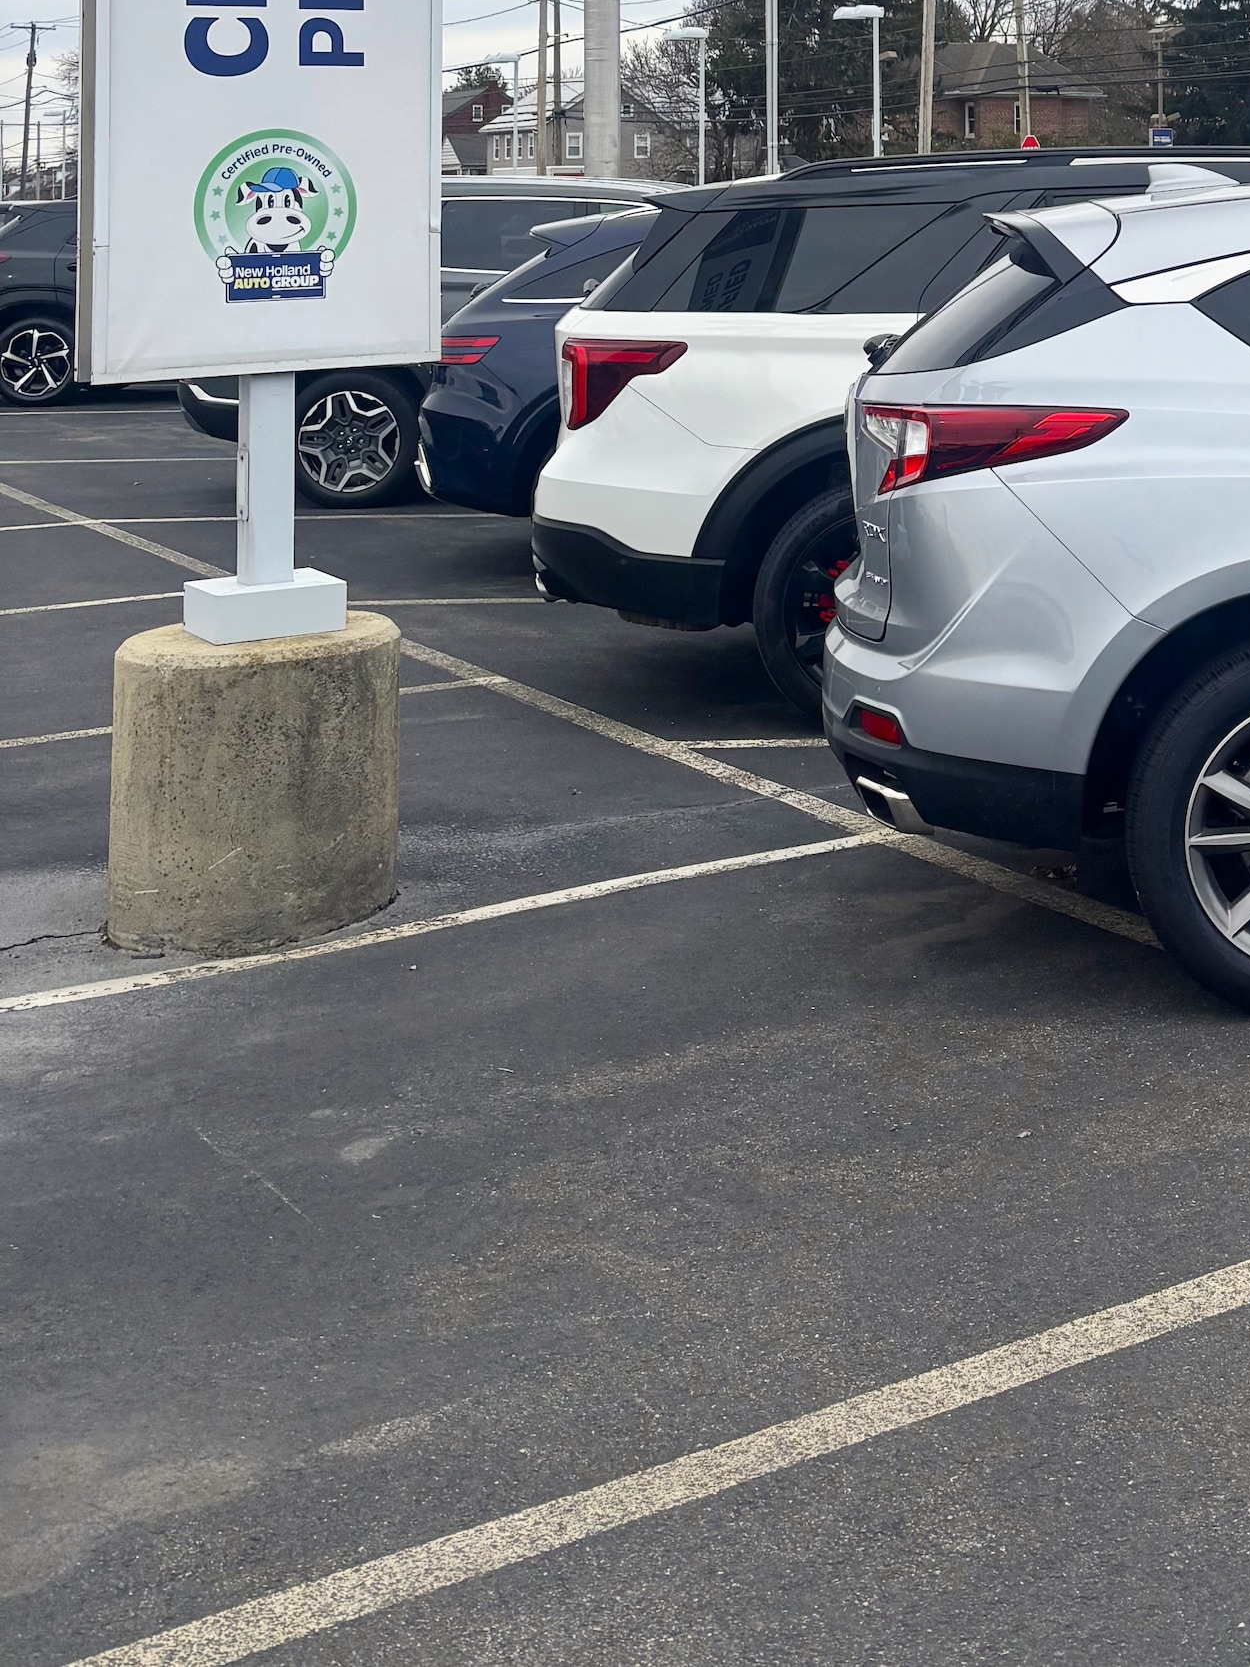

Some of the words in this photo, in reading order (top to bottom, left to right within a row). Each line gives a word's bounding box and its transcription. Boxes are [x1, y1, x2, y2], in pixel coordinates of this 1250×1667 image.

[221, 144, 269, 180] Certified
[272, 143, 333, 178] Pre-Owned
[235, 266, 263, 278] New
[265, 264, 311, 276] Holland
[233, 277, 270, 289] AUTO
[271, 275, 320, 288] GROUP
